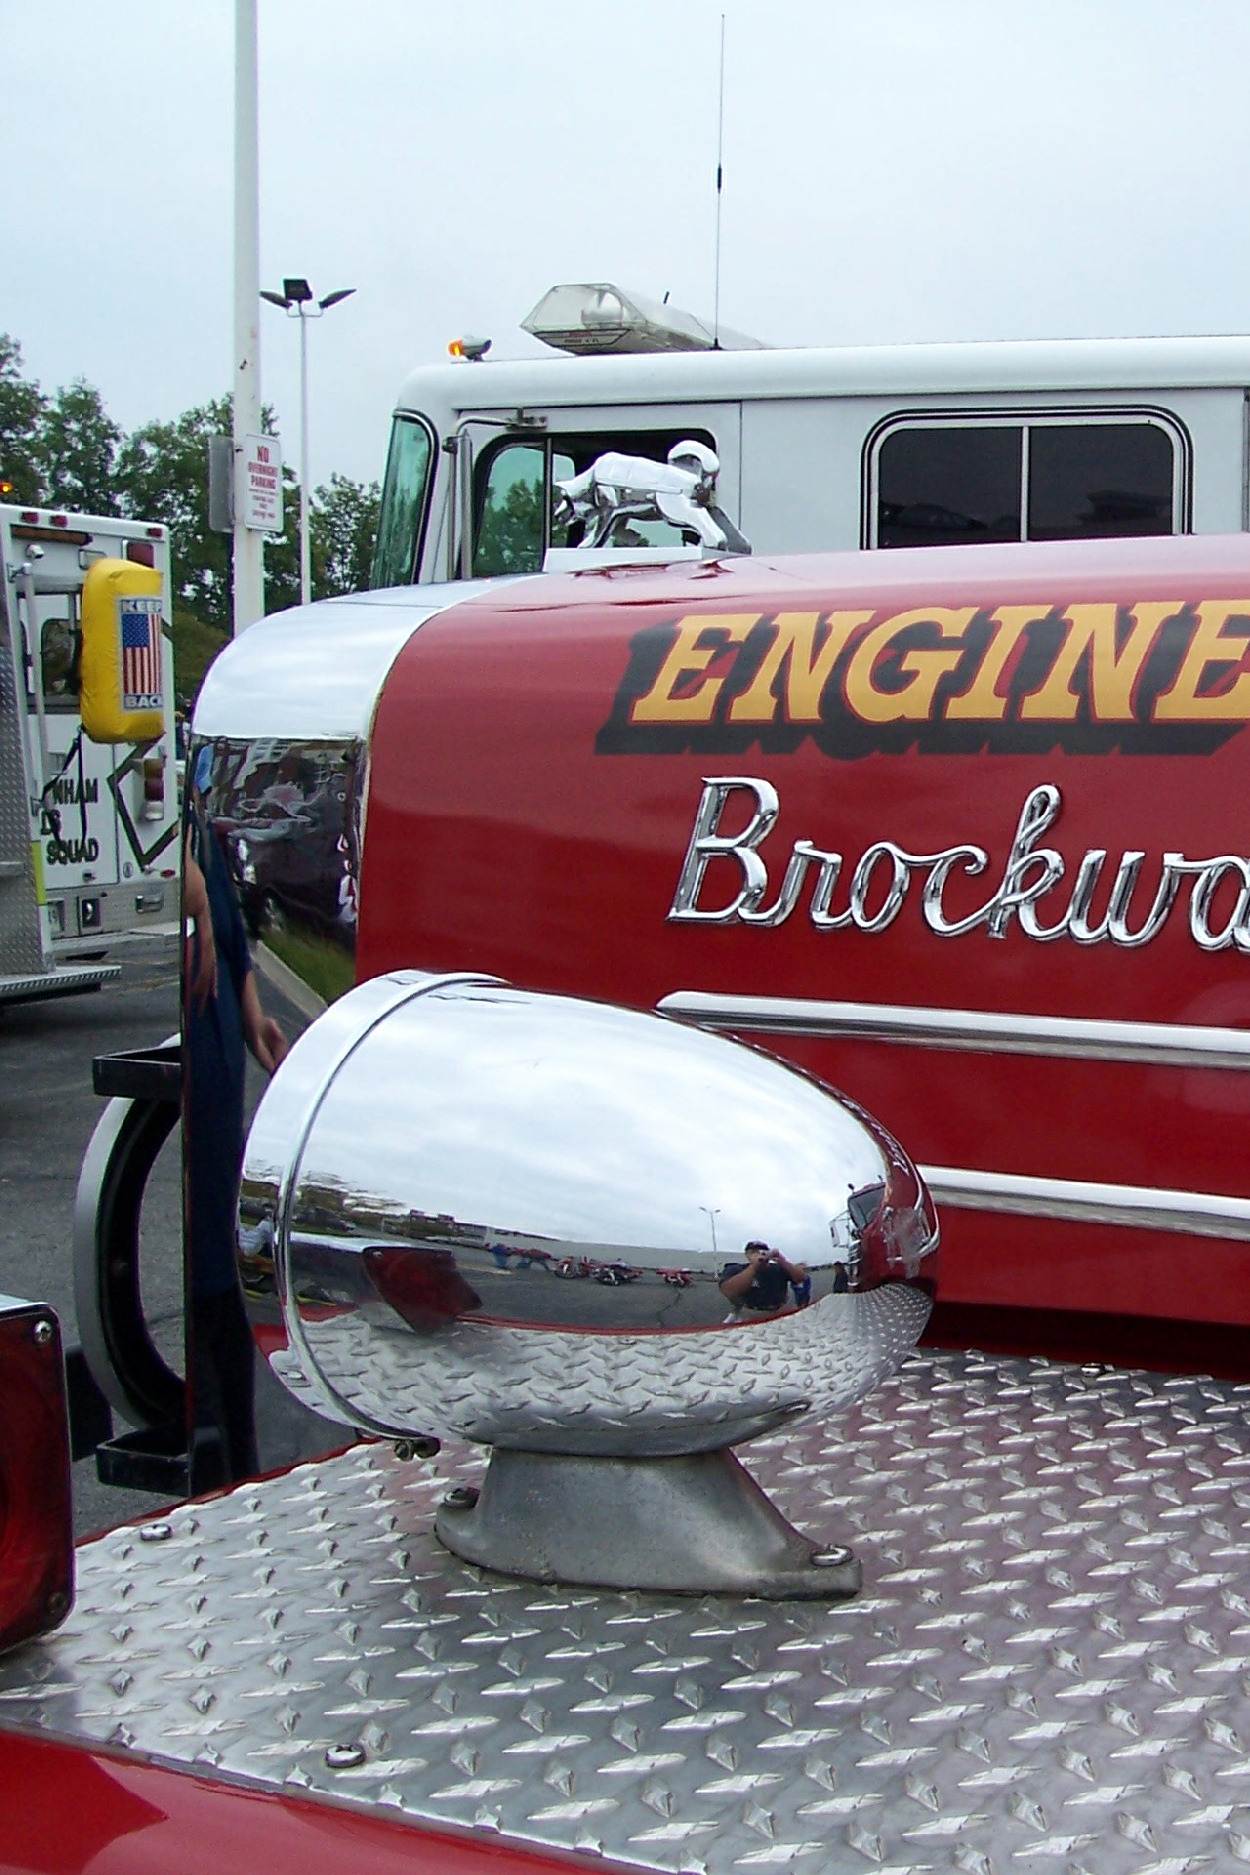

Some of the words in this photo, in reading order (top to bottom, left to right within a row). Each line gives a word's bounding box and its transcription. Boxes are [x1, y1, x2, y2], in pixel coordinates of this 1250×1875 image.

[257, 446, 269, 463] NO
[251, 475, 276, 489] PARKING
[122, 600, 162, 613] KEEP
[46, 837, 99, 865] SQUAD
